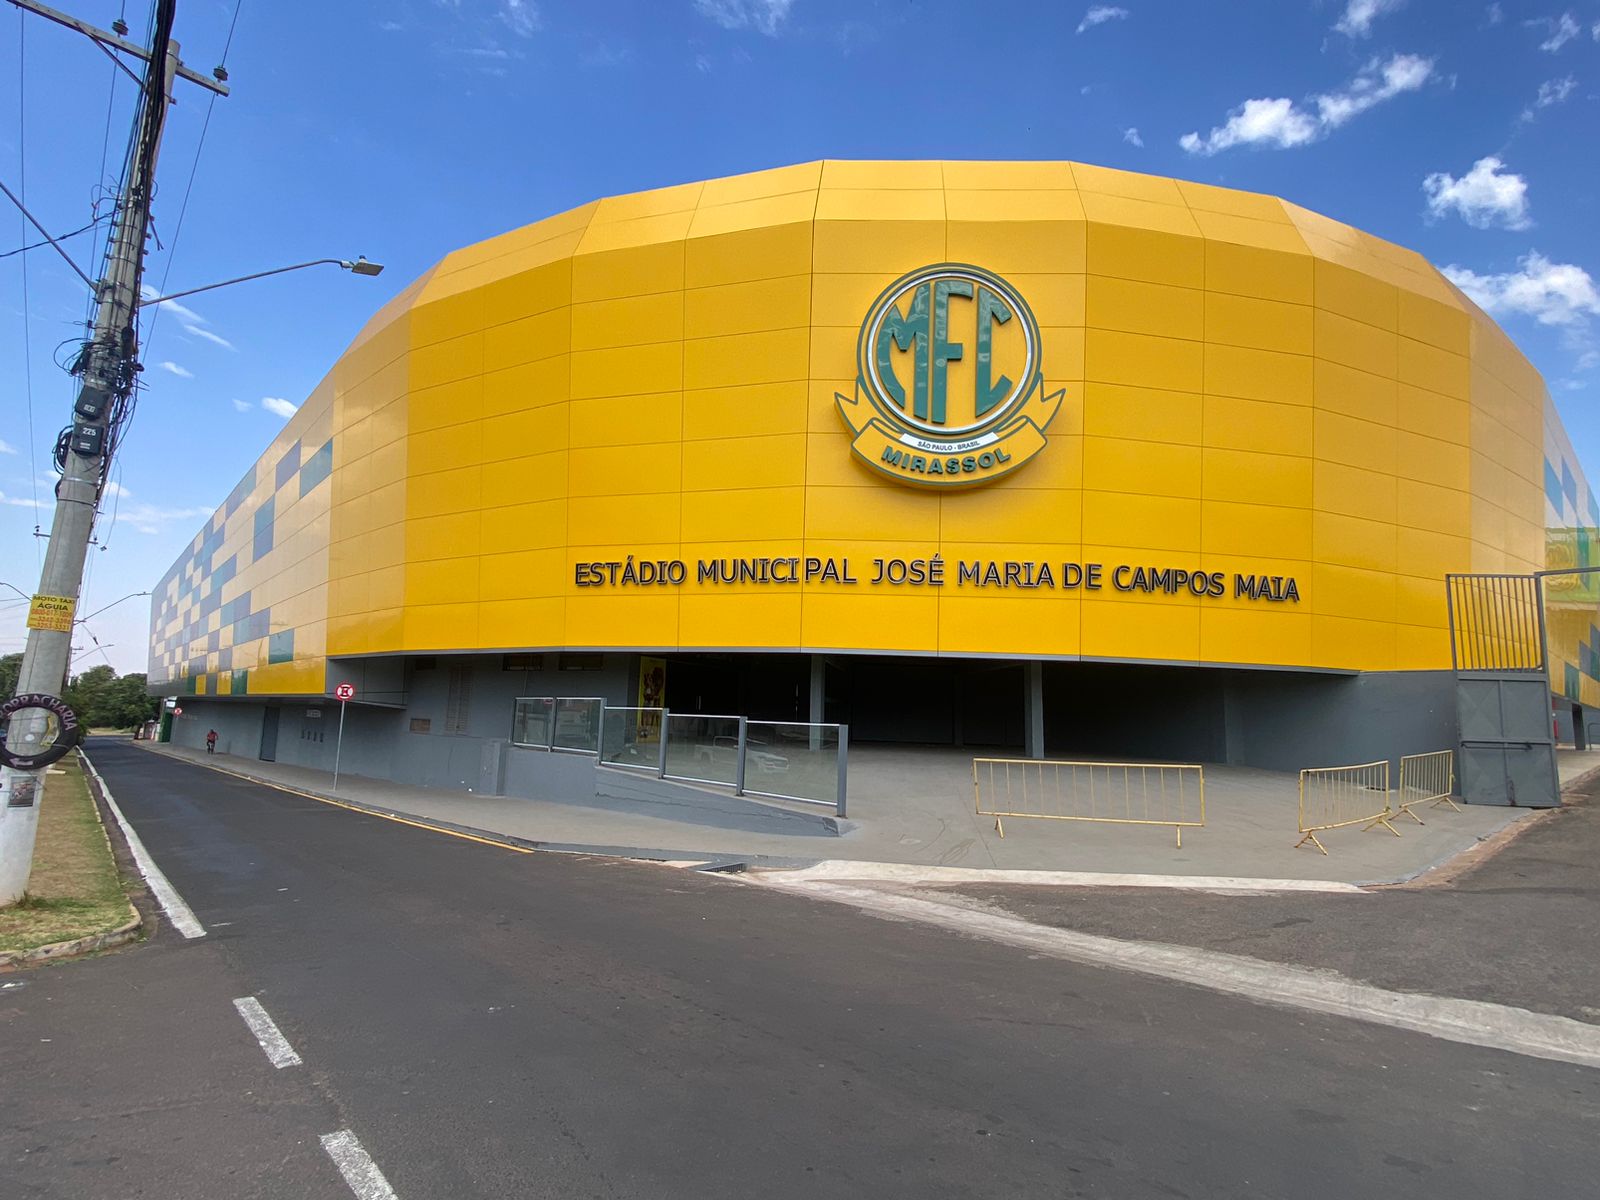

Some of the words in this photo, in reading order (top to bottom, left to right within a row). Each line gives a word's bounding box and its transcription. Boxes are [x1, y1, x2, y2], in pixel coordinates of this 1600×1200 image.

[877, 280, 1013, 424] MFC
[880, 446, 1011, 475] MIRASSOL
[917, 441, 930, 449] SÃO
[957, 441, 980, 450] BRASIL
[575, 554, 687, 586] ESTÁDIO
[871, 553, 944, 586] JOSÉ
[957, 560, 1055, 589] MARIA
[1062, 562, 1102, 589] DE
[1112, 565, 1225, 596] CAMPOS
[1234, 573, 1300, 602] MAIA
